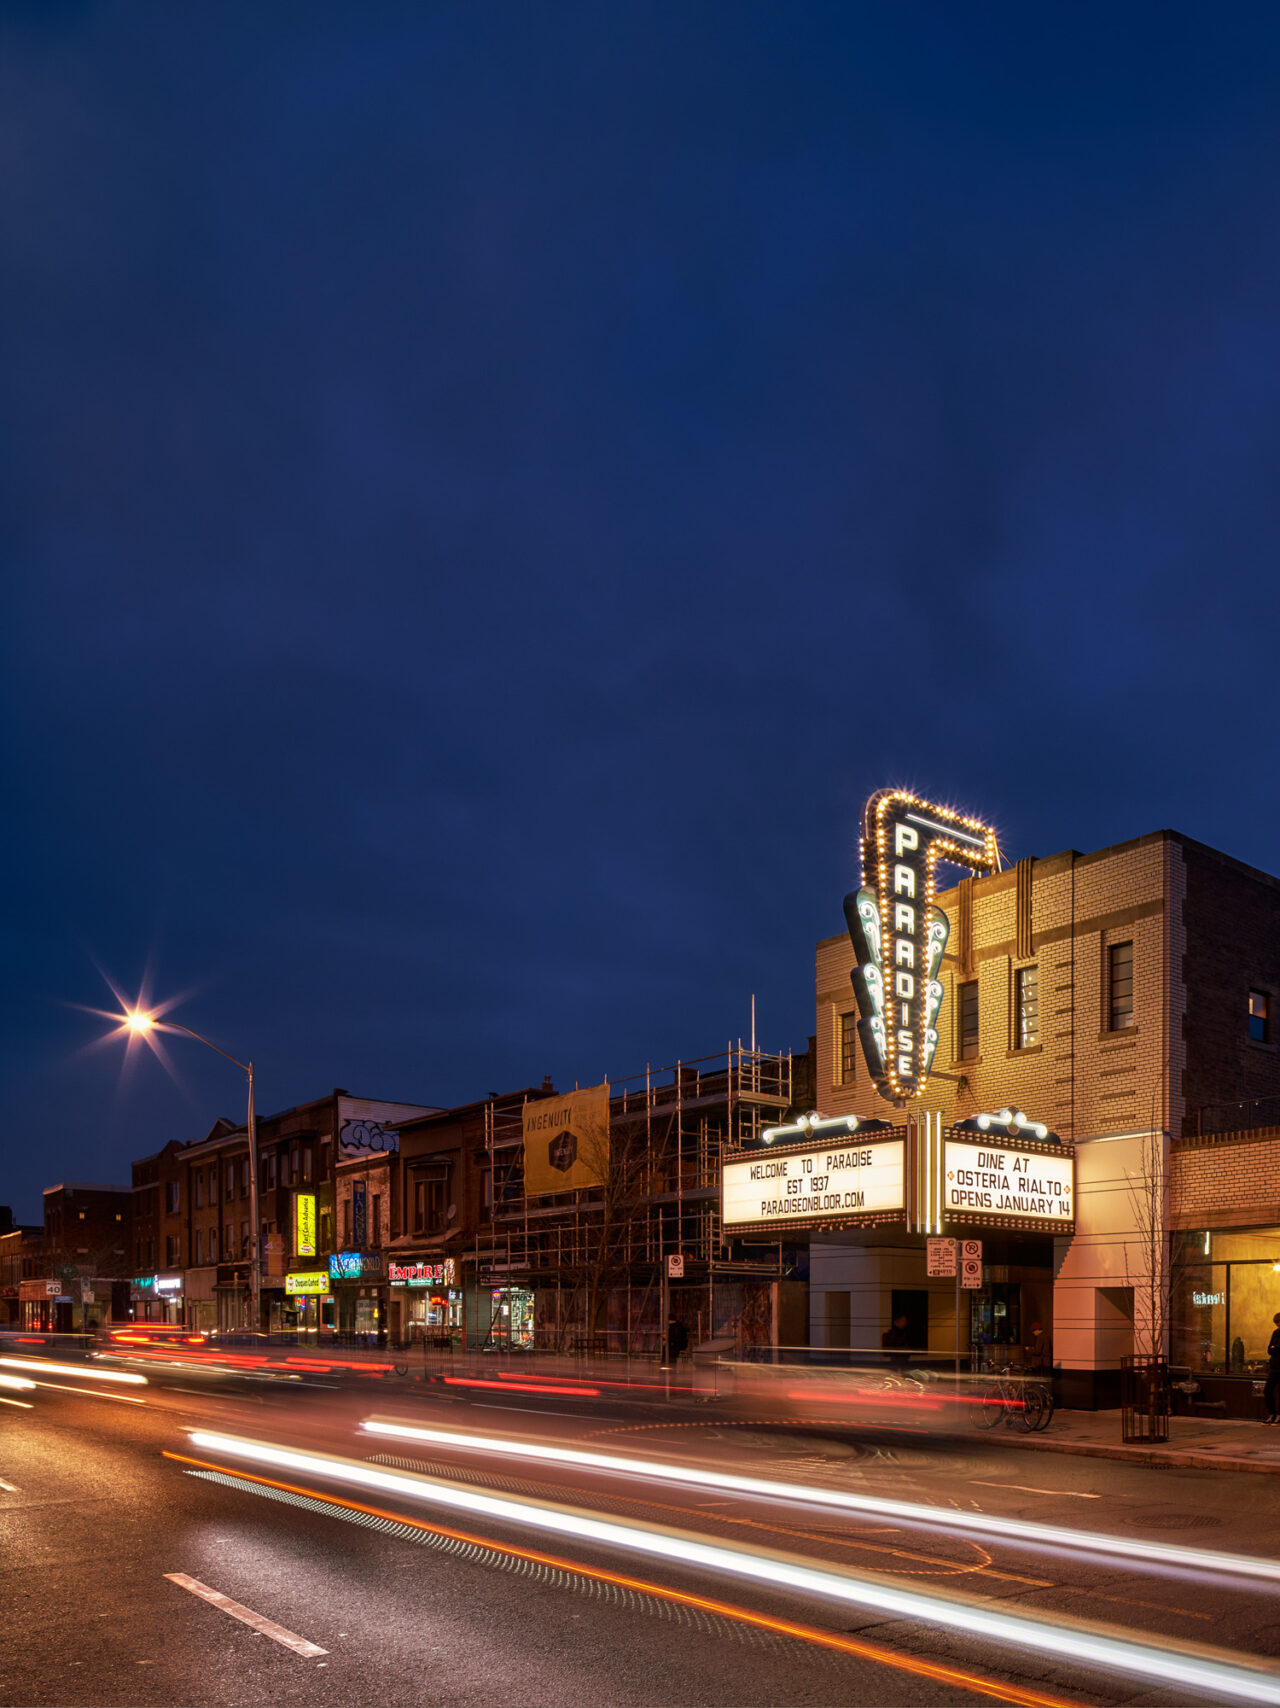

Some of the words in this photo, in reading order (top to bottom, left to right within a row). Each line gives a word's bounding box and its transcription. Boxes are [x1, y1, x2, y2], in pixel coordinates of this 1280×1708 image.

[894, 822, 919, 1077] PARADISE
[750, 1161, 788, 1181] WELCOME
[801, 1158, 813, 1174] TO
[826, 1149, 873, 1171] PARADISE
[977, 1151, 1005, 1171] DINE
[1012, 1156, 1030, 1174] AT
[787, 1178, 803, 1195] EST
[810, 1175, 829, 1193] 1937
[957, 1169, 1010, 1191] OSTERIA
[1018, 1177, 1062, 1197] RIALTO
[761, 1190, 865, 1216] PARADISEONBLOOR.COM
[951, 1189, 992, 1208] OPENS
[995, 1194, 1054, 1214] JANUARY
[1058, 1200, 1070, 1216] 14
[388, 1264, 443, 1280] EMPIRE
